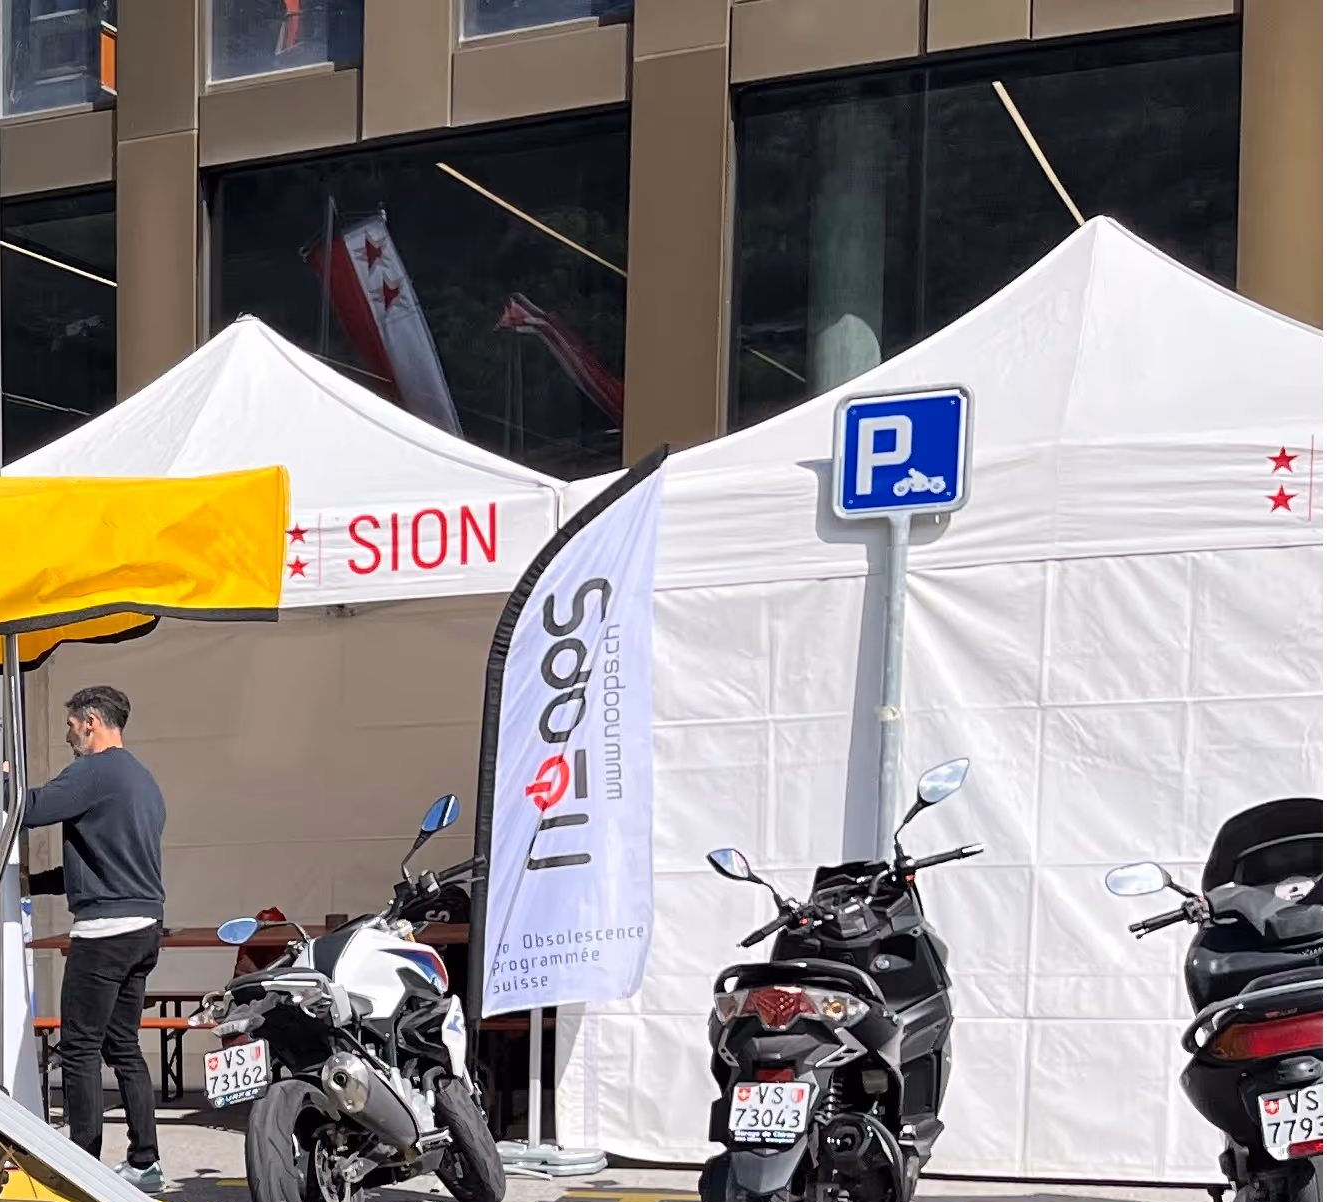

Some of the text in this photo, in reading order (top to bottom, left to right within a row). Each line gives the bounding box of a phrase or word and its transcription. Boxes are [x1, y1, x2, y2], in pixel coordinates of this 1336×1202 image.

[855, 414, 913, 496] P
[347, 501, 497, 575] SION
[601, 622, 626, 801] www.noops.ch
[522, 925, 645, 949] Obsolescence
[223, 1048, 246, 1069] VS
[209, 1065, 263, 1095] 73162
[758, 1085, 785, 1105] VS
[1286, 1089, 1319, 1114] VS
[734, 1108, 802, 1128] 73043
